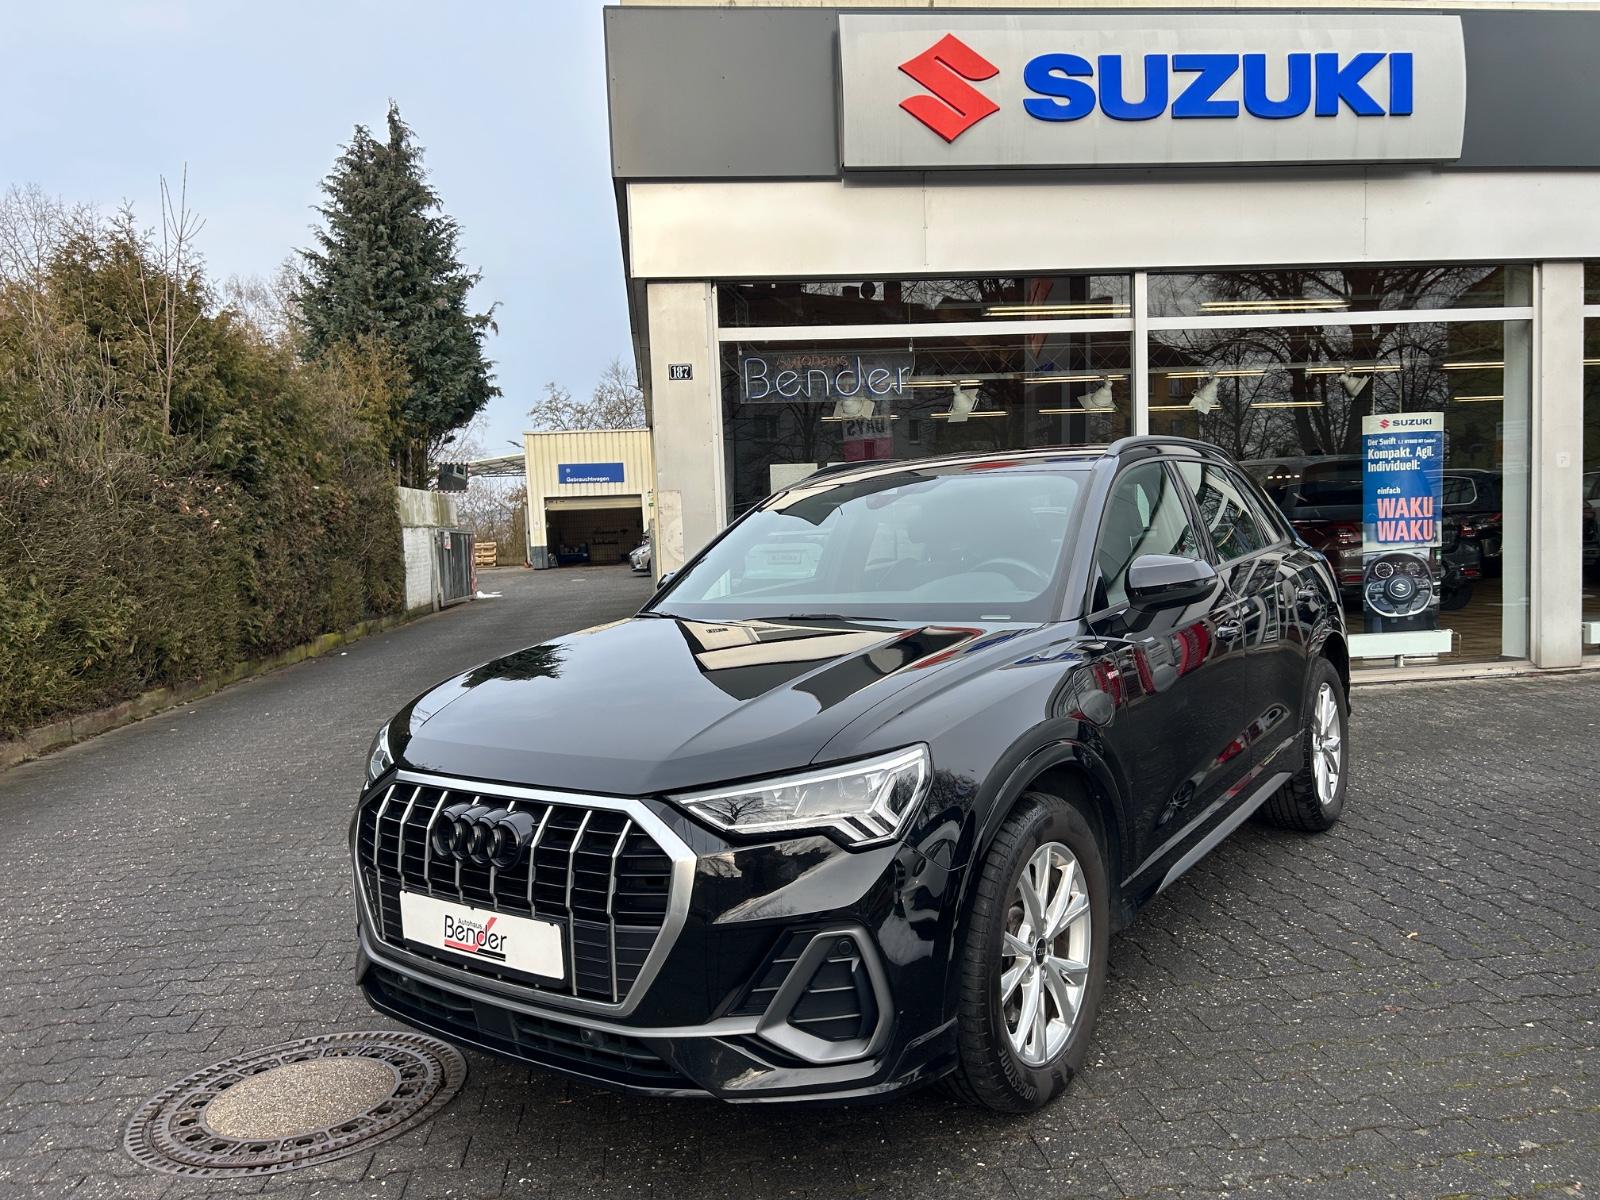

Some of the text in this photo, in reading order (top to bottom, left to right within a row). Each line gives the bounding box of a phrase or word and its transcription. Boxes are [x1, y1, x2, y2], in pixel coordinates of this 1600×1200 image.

[1023, 53, 1413, 121] SUZUKI
[671, 365, 689, 379] 187
[744, 356, 911, 399] Bender
[1392, 418, 1432, 427] SUZUKI
[1367, 438, 1378, 446] Der
[1379, 436, 1396, 446] Swift
[1367, 446, 1435, 460] Kompakt. Agil.
[1367, 460, 1421, 473] Individuell:
[1376, 486, 1401, 495] einfach
[1377, 496, 1433, 519] WAKU
[1377, 519, 1433, 542] WAKU
[458, 918, 482, 929] Autohaus
[444, 914, 507, 951] Bender
